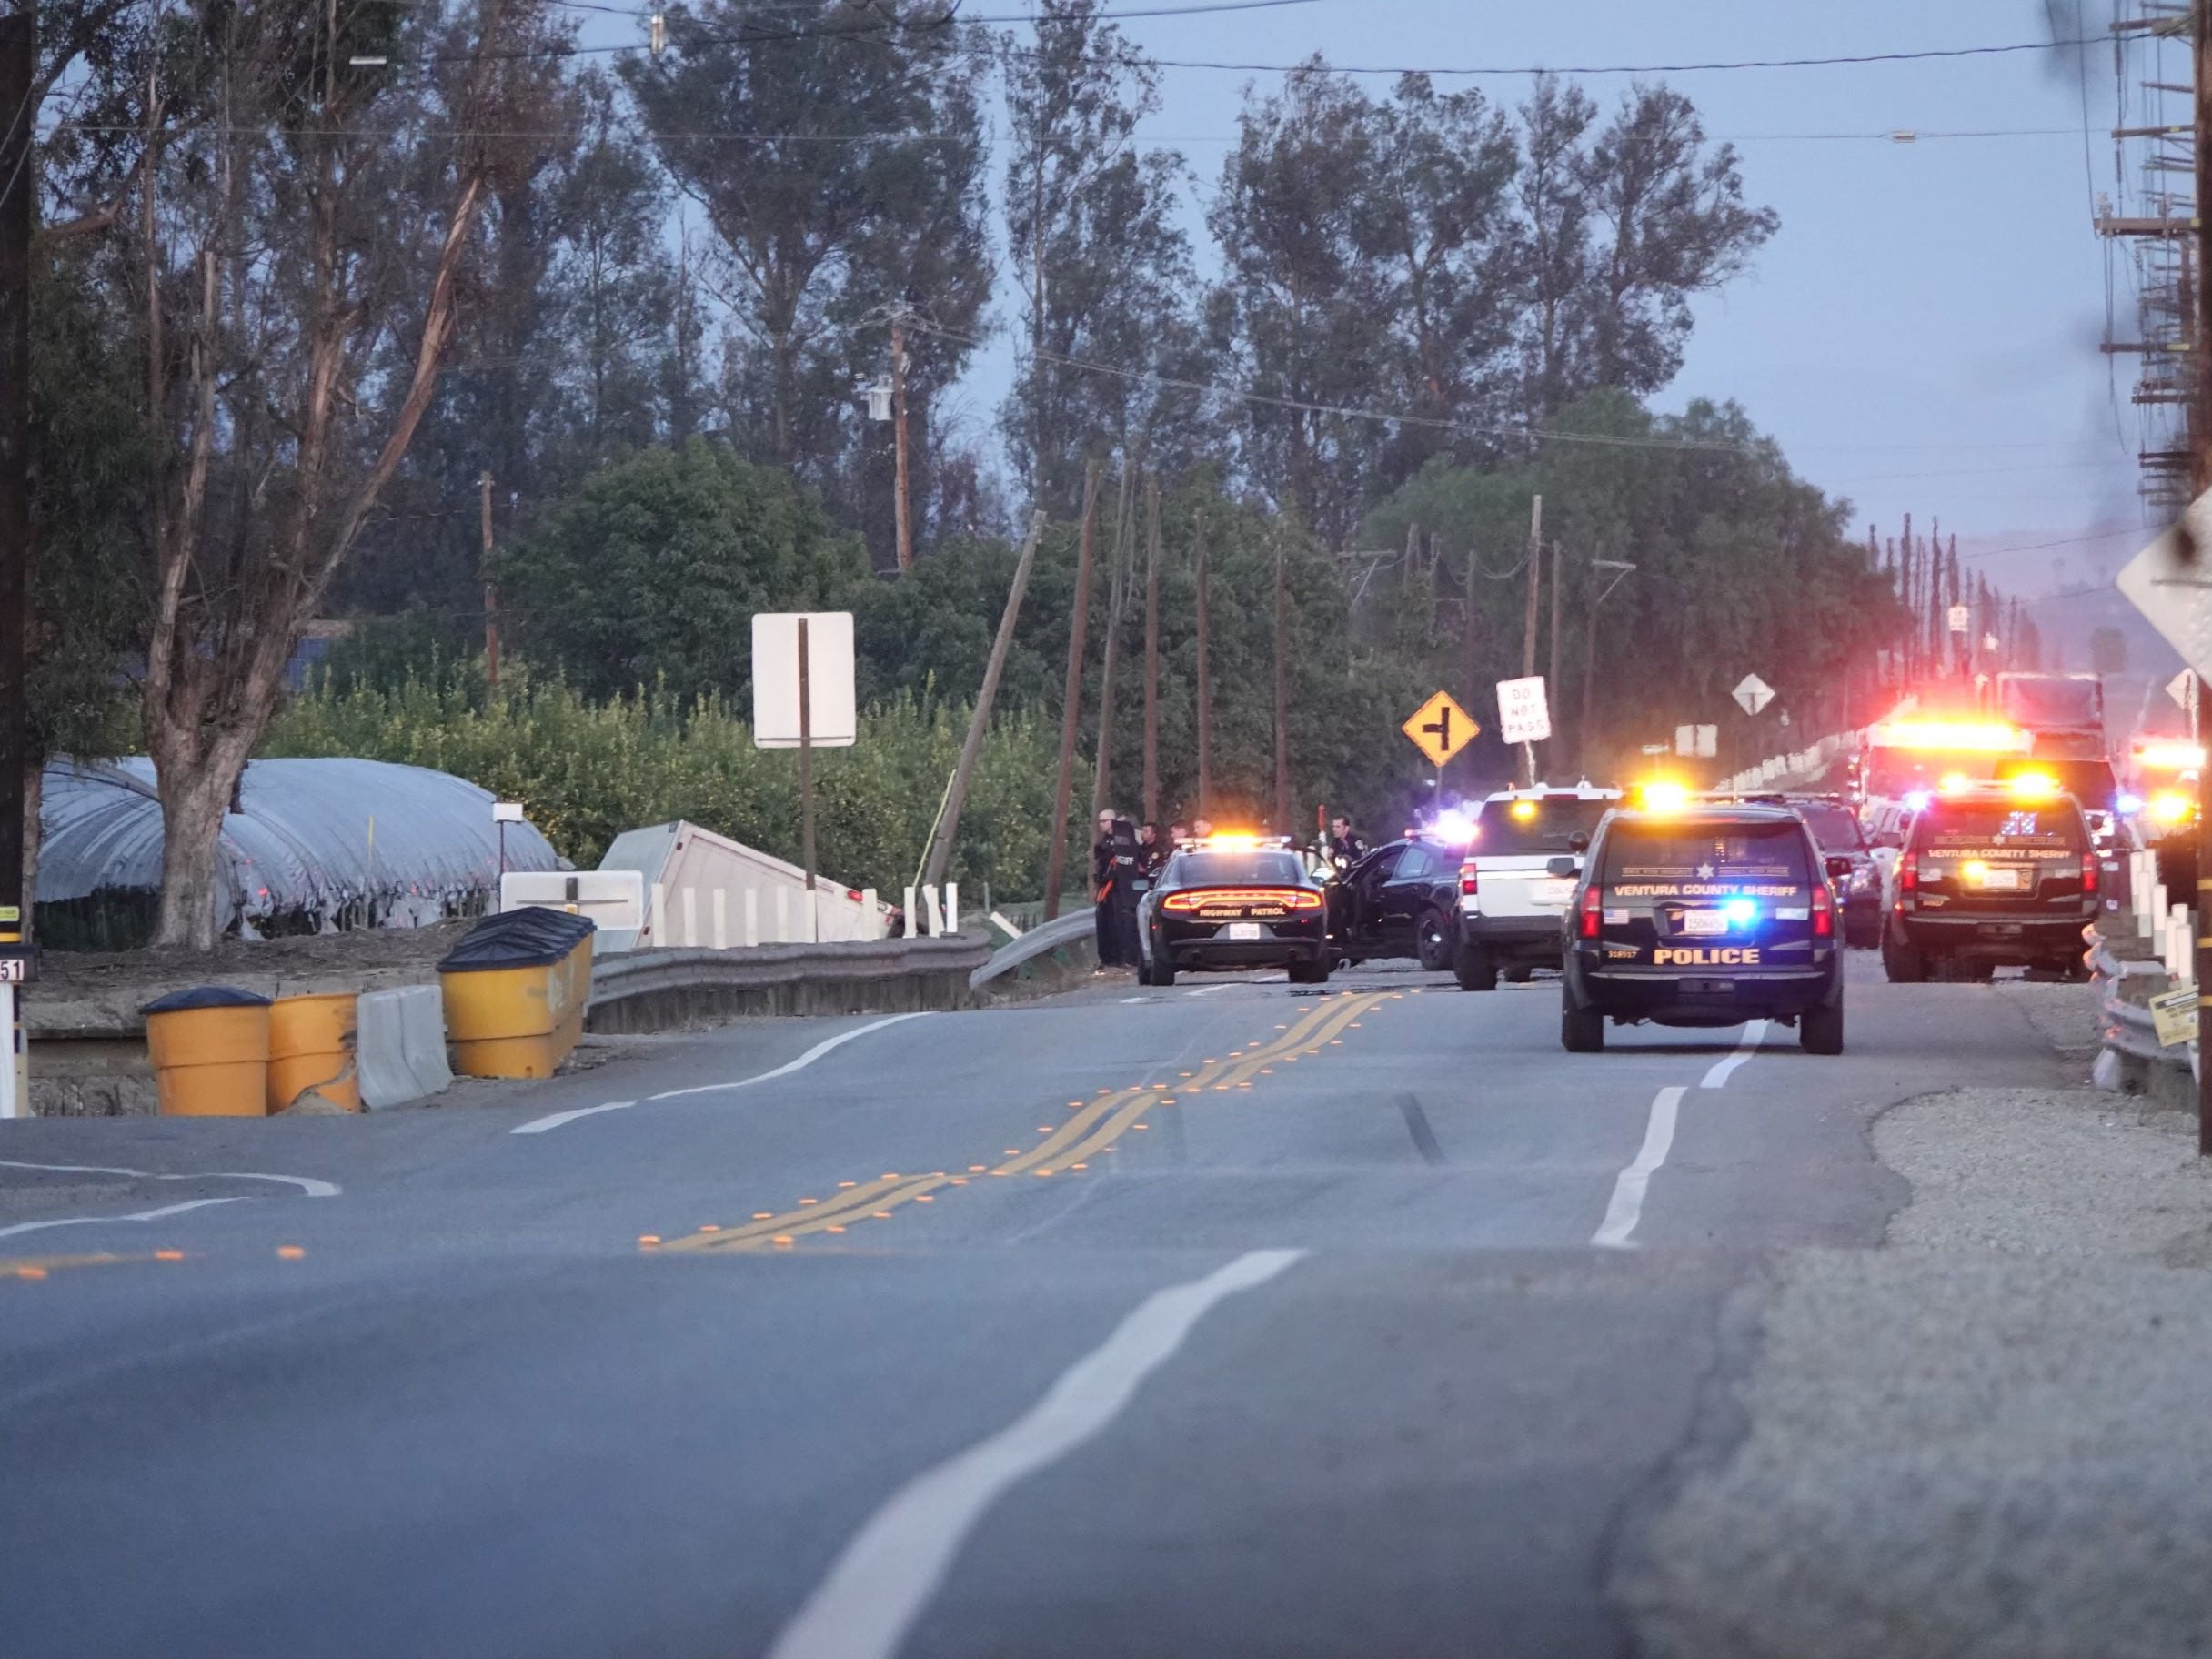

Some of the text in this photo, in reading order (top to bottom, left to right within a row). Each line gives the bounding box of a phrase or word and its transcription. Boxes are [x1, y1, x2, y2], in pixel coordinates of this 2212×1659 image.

[1512, 687, 1530, 700] DO
[1507, 719, 1545, 733] PASS
[1928, 849, 2071, 859] VENTURA COUNTY SHERIFF
[1614, 884, 1797, 896] VENTURA COUNTY SHERIFF
[1199, 908, 1286, 917] HIGHWAY PATROL
[1654, 948, 1761, 965] POLICE
[0, 960, 20, 980] 51
